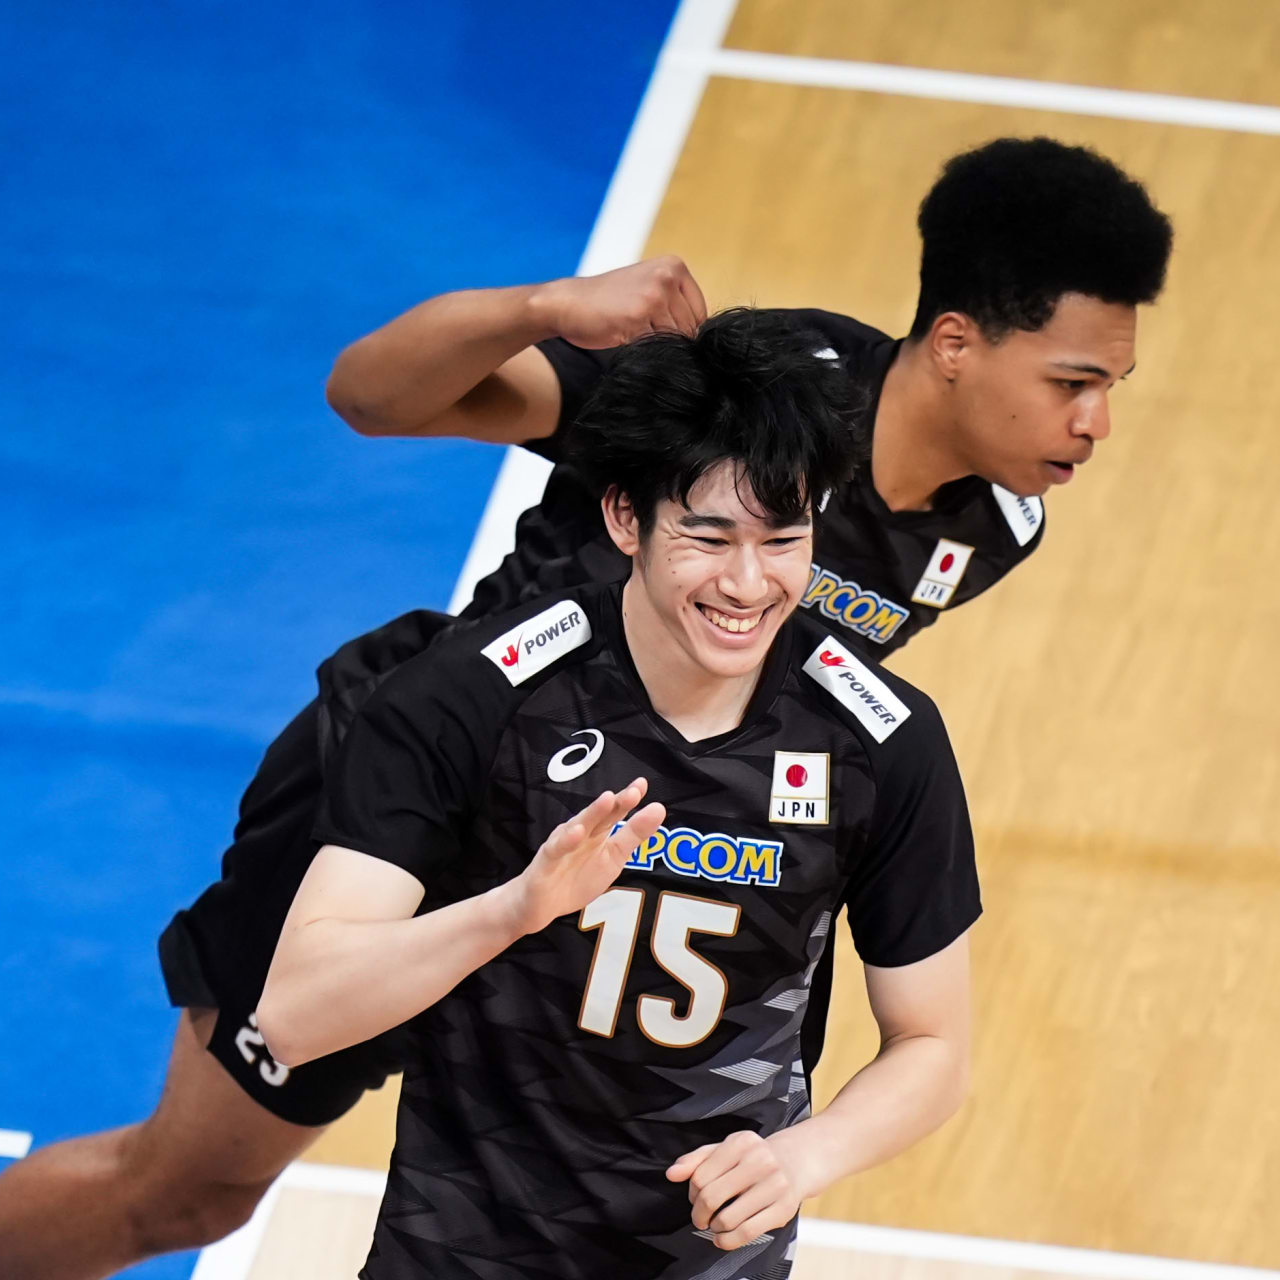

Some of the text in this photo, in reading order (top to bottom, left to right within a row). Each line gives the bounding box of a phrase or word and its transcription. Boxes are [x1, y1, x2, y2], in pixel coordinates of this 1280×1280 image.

[799, 563, 910, 644] PCOM
[920, 584, 946, 602] JPN
[524, 611, 581, 655] POWER
[838, 672, 897, 725] POWER
[778, 801, 815, 818] JPN
[610, 822, 784, 887] PCOM
[577, 886, 741, 1048] 15
